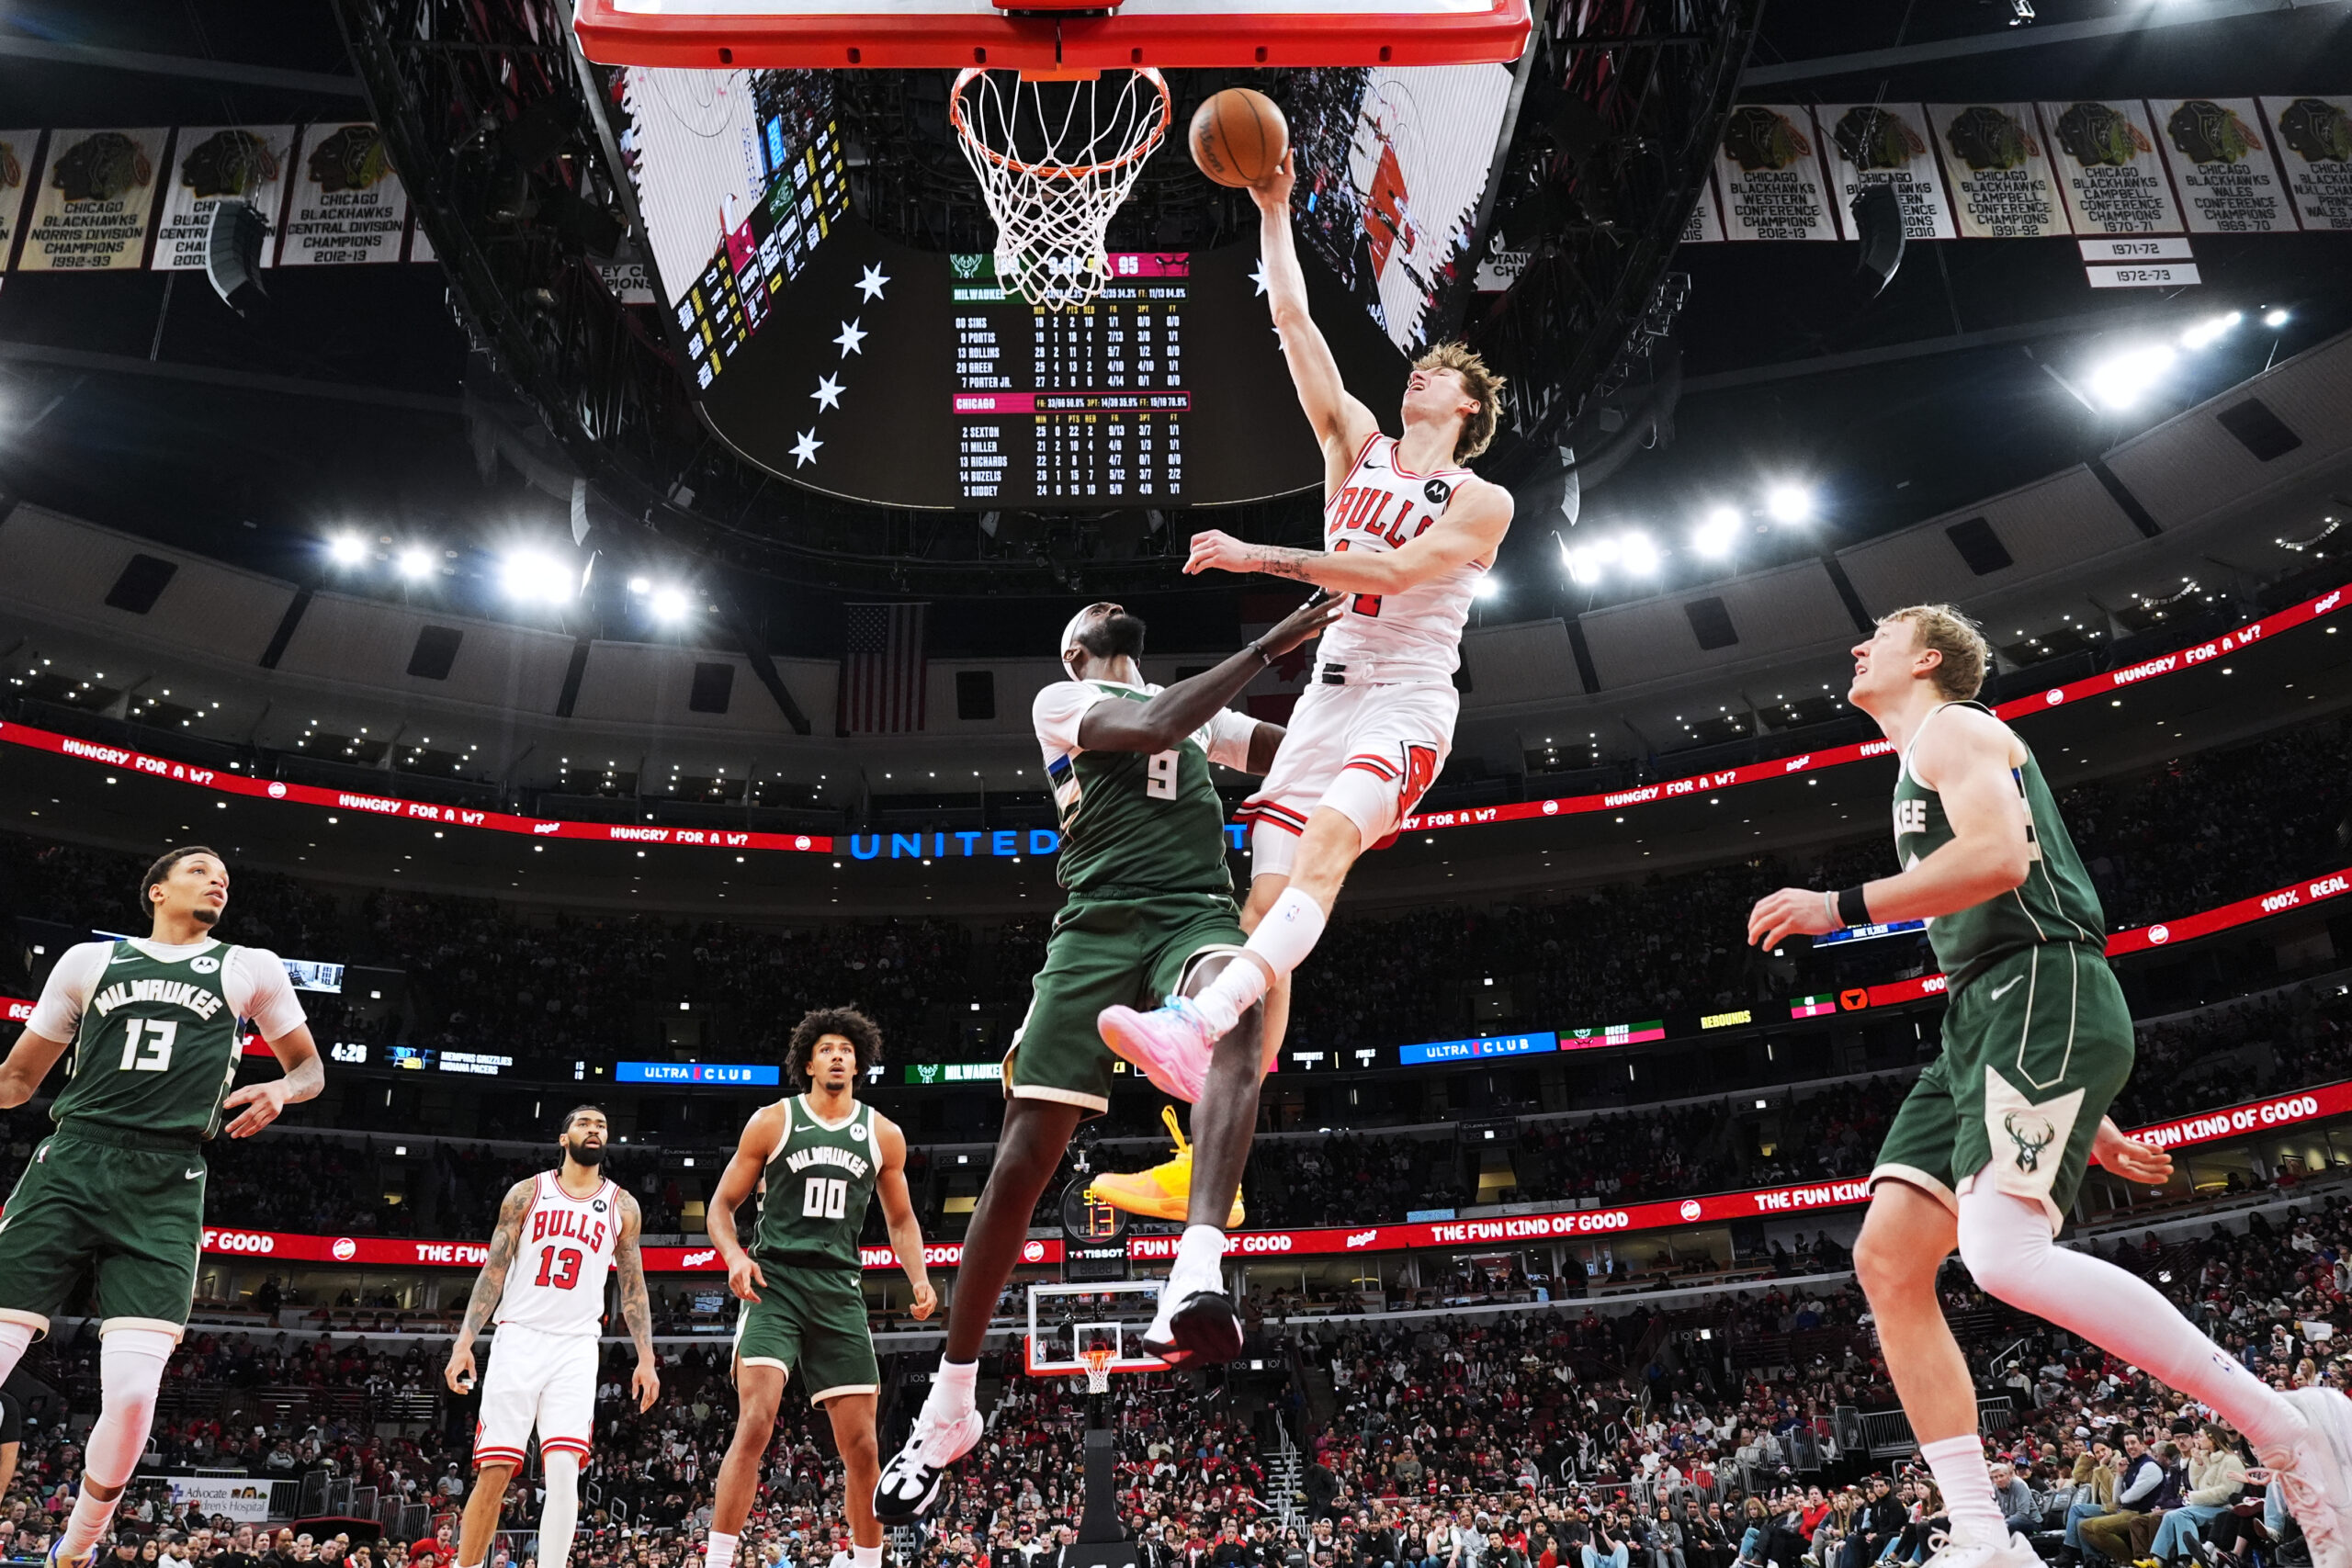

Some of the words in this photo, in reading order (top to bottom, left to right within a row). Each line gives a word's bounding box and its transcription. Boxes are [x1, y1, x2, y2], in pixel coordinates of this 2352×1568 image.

[2085, 167, 2139, 178] CHICAGO
[2198, 164, 2250, 175] CHICAGO
[1743, 172, 1798, 183] CHICAGO
[1858, 173, 1912, 184] CHICAGO
[1973, 171, 2028, 182] CHICAGO
[2185, 175, 2270, 186] BLACKHAWKS
[1730, 183, 1816, 194] BLACKHAWKS
[1961, 180, 2046, 192] BLACKHAWKS
[2073, 177, 2158, 189] BLACKHAWKS
[1973, 192, 2041, 203] CAMPBELL
[2084, 188, 2154, 199] CAMPBELL
[2211, 186, 2254, 197] WALES
[320, 193, 379, 206] CHICAGO
[1743, 194, 1807, 205] WESTERN
[2080, 198, 2165, 210] CONFERENCE
[2194, 197, 2278, 209] CONFERENCE
[64, 202, 124, 214] CHICAGO
[300, 207, 393, 220] BLACKHAWKS
[1735, 205, 1820, 216] CONFERENCE
[1968, 203, 2052, 214] CONFERENCE
[43, 214, 138, 227] BLACKHAWKS
[1977, 213, 2049, 225] CHAMPIONS
[2088, 209, 2162, 221] CHAMPIONS
[2203, 209, 2276, 220] CHAMPIONS
[287, 222, 346, 235] CENTRAL
[349, 220, 402, 232] DIVISION
[1743, 217, 1816, 228] CHAMPIONS
[2104, 221, 2154, 232] 1970-71
[2216, 220, 2271, 231] 1969-70
[31, 229, 83, 241] NORRIS
[85, 227, 143, 240] DIVISION
[1758, 228, 1806, 239] 2012-13
[1992, 225, 2040, 236] 1991-92
[303, 235, 382, 248] CHAMPIONS
[44, 242, 125, 254] CHAMPIONS
[2112, 243, 2160, 255] 1971-72
[51, 255, 111, 267] 1992-93
[313, 250, 367, 263] 2012-13
[1118, 256, 1138, 275] 95
[2116, 269, 2171, 282] 1972-73
[955, 317, 967, 329] 00
[967, 317, 988, 329] SIMS
[960, 332, 967, 344] 9
[967, 332, 996, 344] PORTIS
[957, 347, 967, 359] 13
[968, 346, 1001, 359] ROLLINS
[956, 362, 967, 374] 20
[968, 361, 993, 374] GREEN
[961, 377, 967, 389] 7
[968, 376, 998, 389] PORTER
[1000, 376, 1012, 388] JR.
[956, 398, 996, 410] CHICAGO
[1035, 414, 1047, 424] MIN
[1055, 414, 1059, 423] F
[1068, 414, 1080, 423] PTS
[1084, 414, 1097, 423] REB
[1111, 413, 1119, 423] FG
[1138, 412, 1151, 422] 3PT
[1170, 412, 1178, 422] FT
[962, 426, 968, 438] 2
[969, 426, 1000, 438] SEXTON
[960, 441, 968, 453] 11
[970, 441, 998, 453] MILLER
[959, 456, 969, 468] 13
[970, 456, 1008, 468] RICHARDS
[959, 470, 969, 482] 14
[970, 470, 1002, 482] BUZELIS
[963, 485, 969, 497] 3
[2113, 654, 2177, 684] HUNGRY
[2185, 643, 2217, 664] FOR
[2222, 637, 2233, 651] A
[2237, 625, 2262, 644] W?
[62, 739, 130, 765] HUNGRY
[135, 756, 167, 775] FOR
[173, 765, 185, 778] A
[189, 769, 215, 785] W?
[1147, 749, 1180, 801] 9
[1604, 786, 1659, 807] HUNGRY
[1667, 779, 1694, 795] FOR
[1699, 777, 1710, 790] A
[1714, 771, 1737, 786] W?
[338, 794, 401, 813] HUNGRY
[408, 804, 438, 819] FOR
[444, 809, 455, 821] A
[461, 811, 485, 825] W?
[1427, 813, 1454, 827] FOR
[1460, 812, 1470, 823] A
[1475, 808, 1498, 821] W?
[610, 827, 669, 841] HUNGRY
[675, 830, 706, 843] FOR
[709, 832, 719, 844] A
[727, 833, 749, 846] W?
[850, 829, 1059, 861] UNITED
[2261, 889, 2300, 912] 100%
[2309, 875, 2350, 898] REAL
[94, 979, 223, 1021] MILWAUKEE
[1701, 1010, 1751, 1030] REBOUNDS
[1604, 1024, 1629, 1035] BUCKS
[119, 1018, 178, 1072] 13
[1605, 1034, 1629, 1045] BULLS
[331, 1042, 368, 1064] 4:26
[1355, 1048, 1376, 1058] FOULS
[1426, 1044, 1469, 1058] ULTRA
[1483, 1038, 1530, 1053] CLUB
[440, 1051, 476, 1065] MEMPHIS
[476, 1054, 514, 1066] GRIZZLIES
[1293, 1051, 1324, 1061] TIMEOUTS
[439, 1060, 469, 1073] INDIANA
[469, 1064, 499, 1076] PACERS
[575, 1061, 585, 1070] 15
[574, 1070, 584, 1080] 19
[644, 1066, 689, 1078] ULTRA
[705, 1067, 752, 1081] CLUB
[944, 1064, 1002, 1081] MILWAUKE
[2143, 1130, 2181, 1148] FUN
[2182, 1115, 2231, 1141] KIND
[2232, 1109, 2257, 1130] OF
[2260, 1096, 2318, 1124] GOOD
[786, 1146, 869, 1179] MILWAUKEE
[802, 1177, 848, 1220] 00
[1754, 1190, 1791, 1211] THE
[1792, 1185, 1831, 1206] FUN
[1089, 1205, 1115, 1236] 13
[532, 1210, 606, 1254] BULLS
[1430, 1224, 1466, 1242] THE
[1467, 1221, 1503, 1240] FUN
[1506, 1217, 1550, 1237] KIND
[1552, 1215, 1576, 1234] OF
[1578, 1212, 1629, 1231] GOOD
[219, 1232, 275, 1253] GOOD
[1134, 1239, 1169, 1257] FUN
[1243, 1235, 1292, 1252] GOOD
[415, 1244, 452, 1262] THE
[1083, 1248, 1125, 1258] TISSOT
[535, 1245, 583, 1291] 13
[185, 1487, 228, 1499] Advocate
[229, 1500, 266, 1514] Hospital
